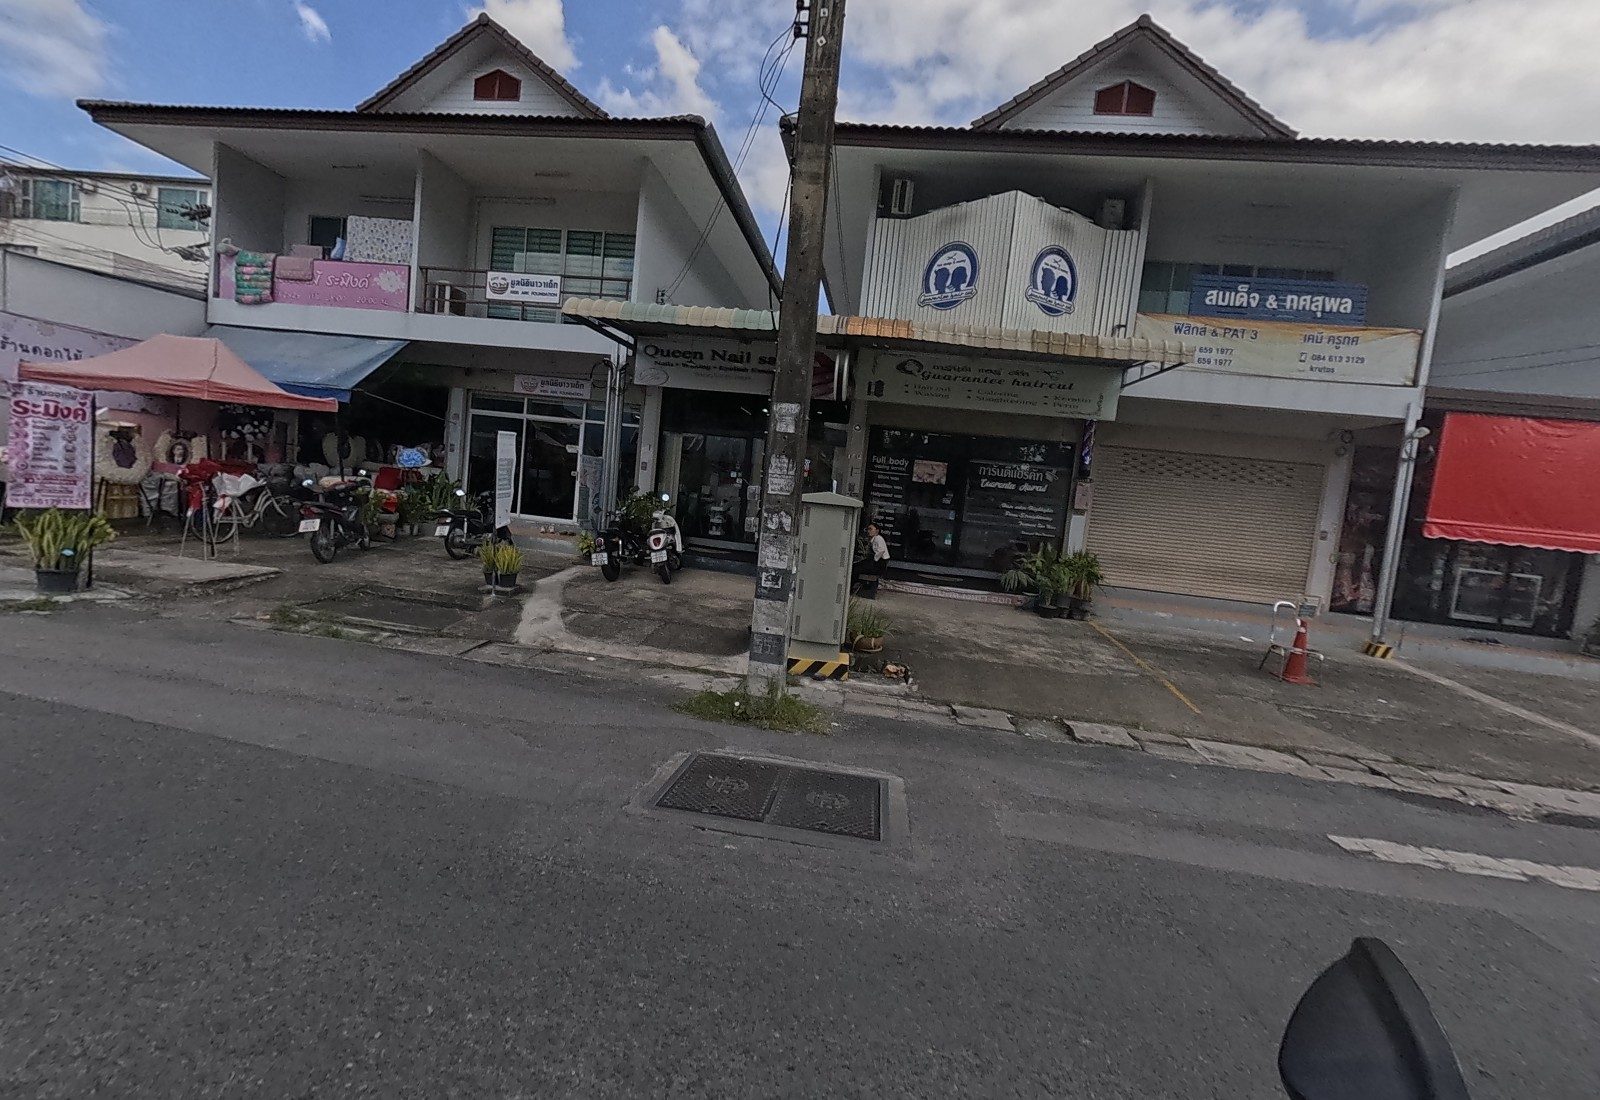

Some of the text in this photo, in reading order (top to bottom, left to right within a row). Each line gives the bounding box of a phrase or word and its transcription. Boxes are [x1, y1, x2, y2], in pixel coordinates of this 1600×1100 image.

[1205, 284, 1352, 318] สมเด็จ & ทศสุพล
[1223, 327, 1247, 339] PAT
[1250, 330, 1258, 340] 3
[0, 335, 83, 361] ร้านดอกไม้
[644, 344, 704, 360] Queen
[711, 349, 752, 364] Nail
[1199, 346, 1234, 356] 659 1977
[1197, 357, 1233, 366] 659 1977
[1011, 378, 1075, 390] haircut
[12, 399, 88, 422] ระมิงค์
[872, 455, 909, 468] Full body
